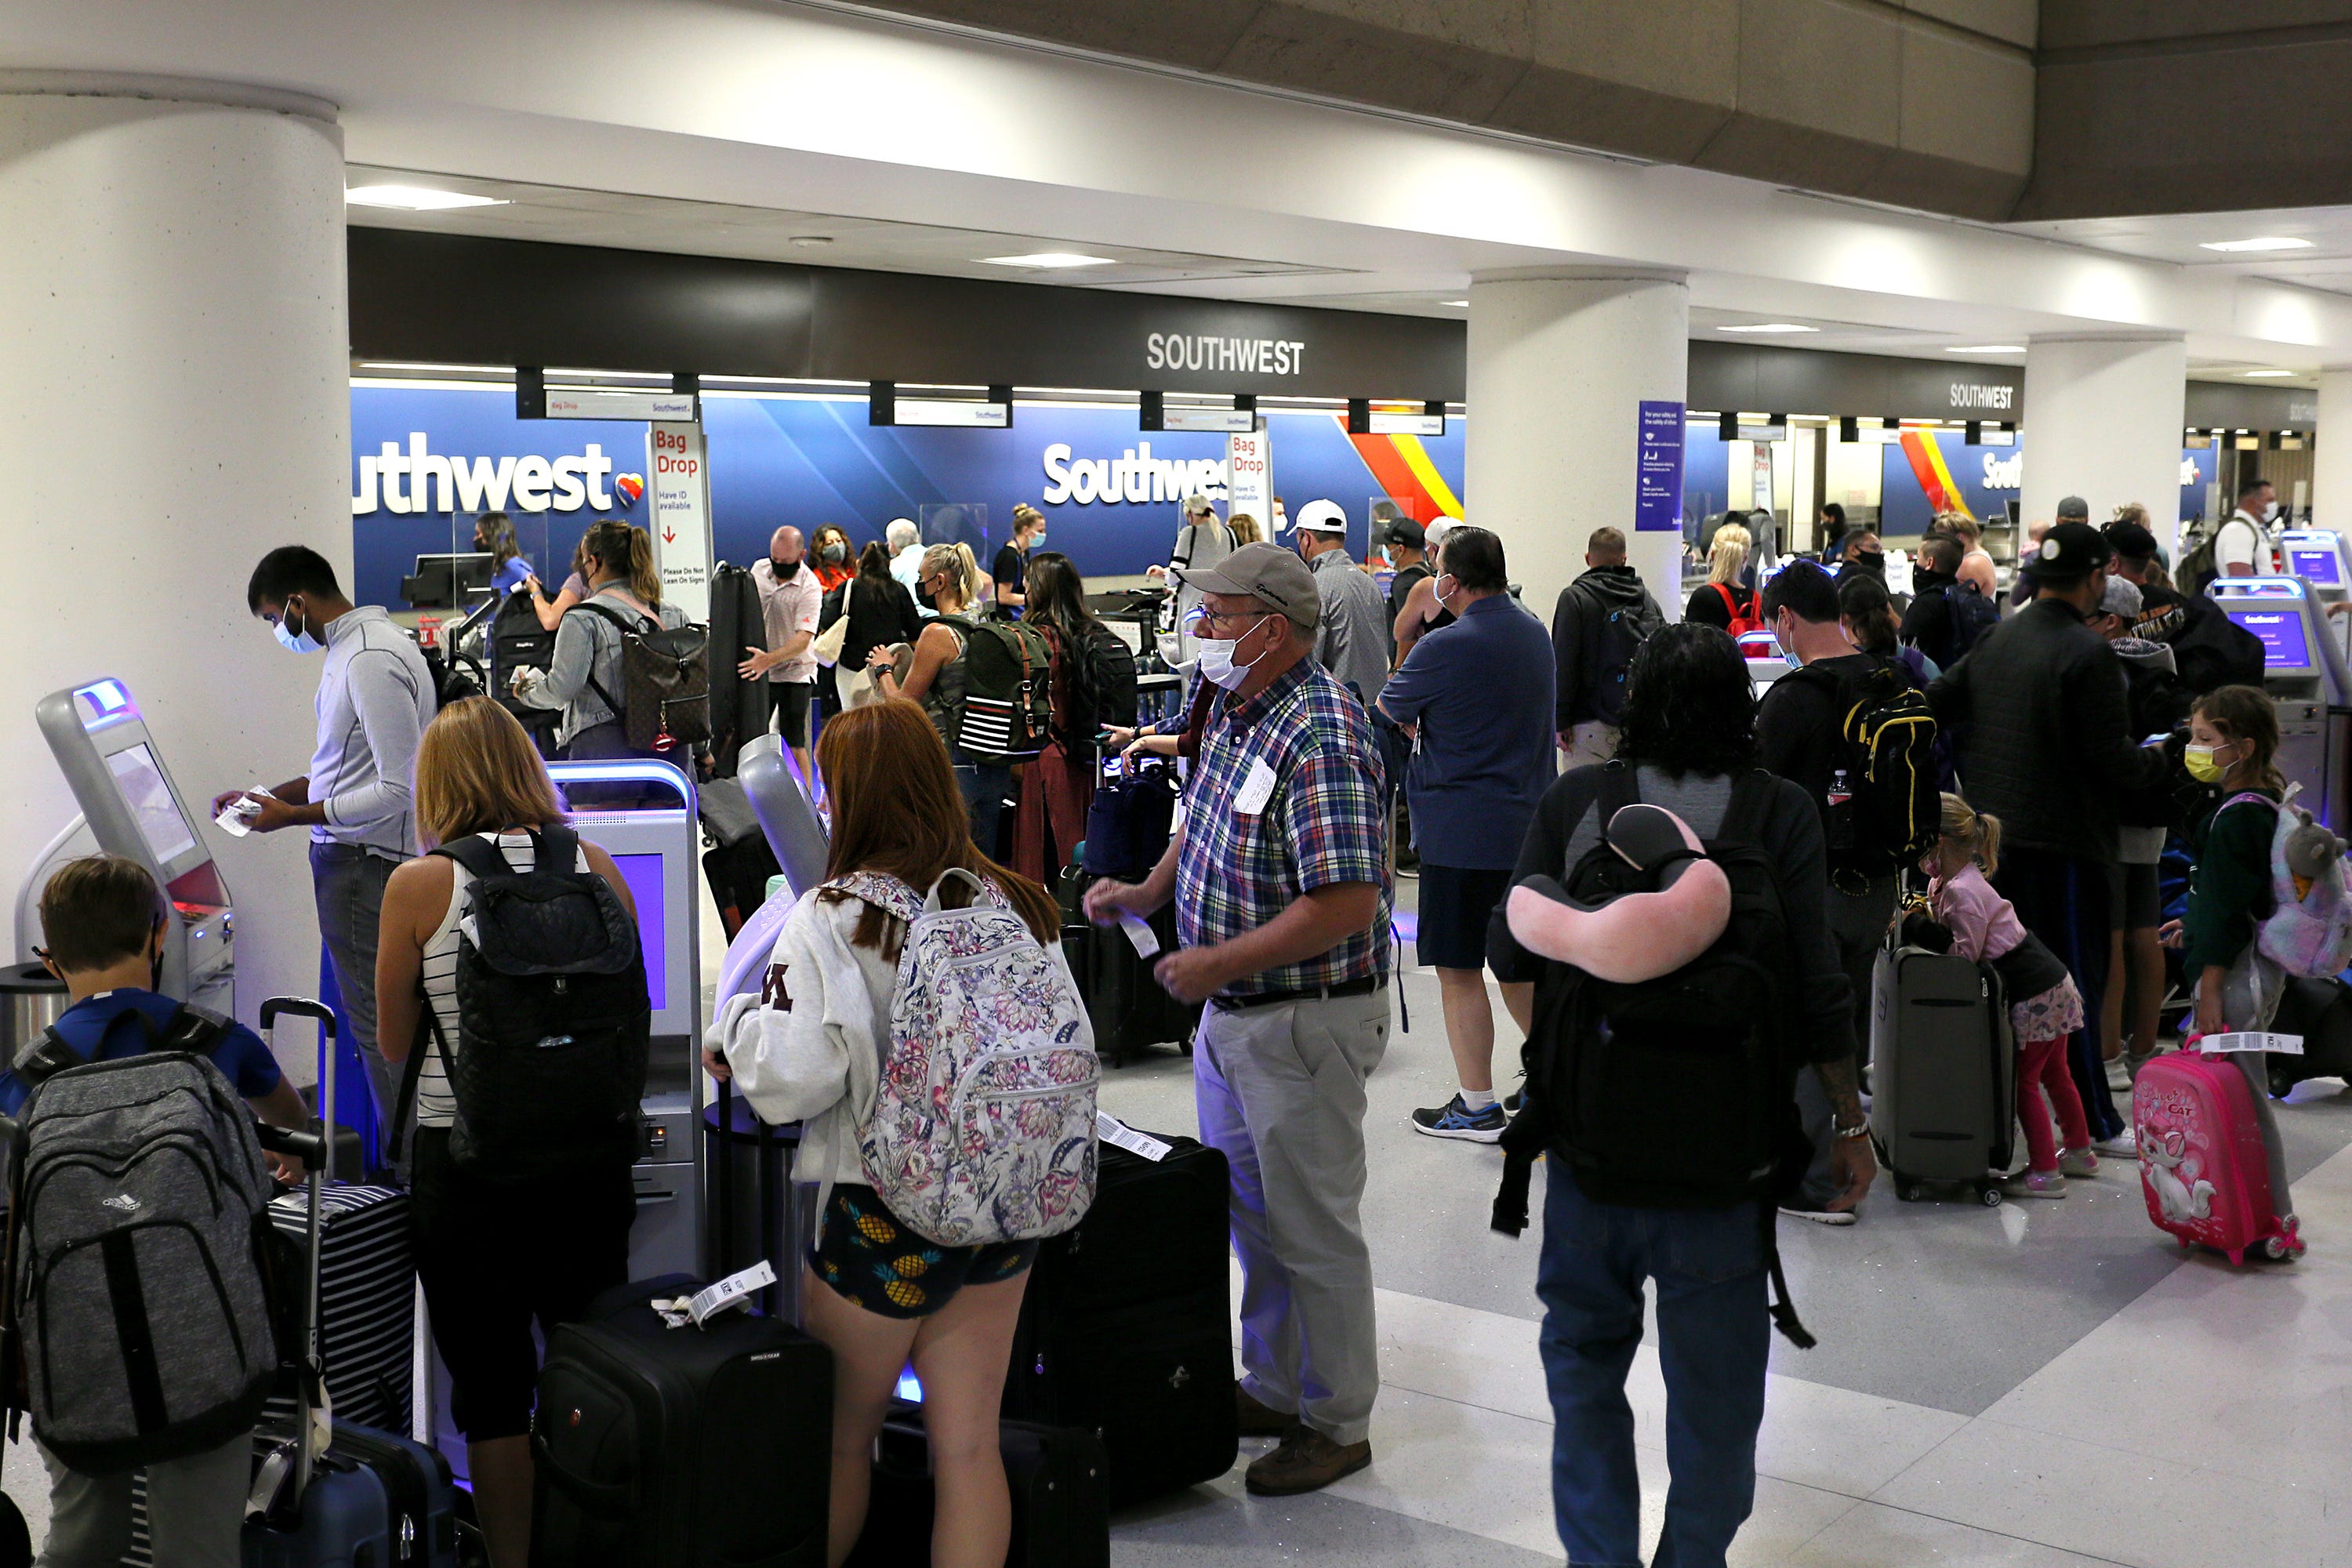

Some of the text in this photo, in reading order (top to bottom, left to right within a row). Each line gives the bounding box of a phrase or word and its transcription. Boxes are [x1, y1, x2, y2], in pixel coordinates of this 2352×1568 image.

[1147, 332, 1305, 375] SOUTHWEST
[1950, 383, 2013, 408] SOUTHWEST
[652, 404, 688, 412] Southwest
[656, 430, 686, 453] Bag
[1233, 437, 1255, 456] Bag
[353, 432, 612, 514] uthwest
[658, 456, 697, 477] Drop
[1043, 441, 1229, 504] Southwes
[1234, 457, 1263, 474] Drop
[1755, 459, 1769, 472] Drop
[2168, 1104, 2193, 1116] CAT
[102, 1197, 141, 1210] adidas
